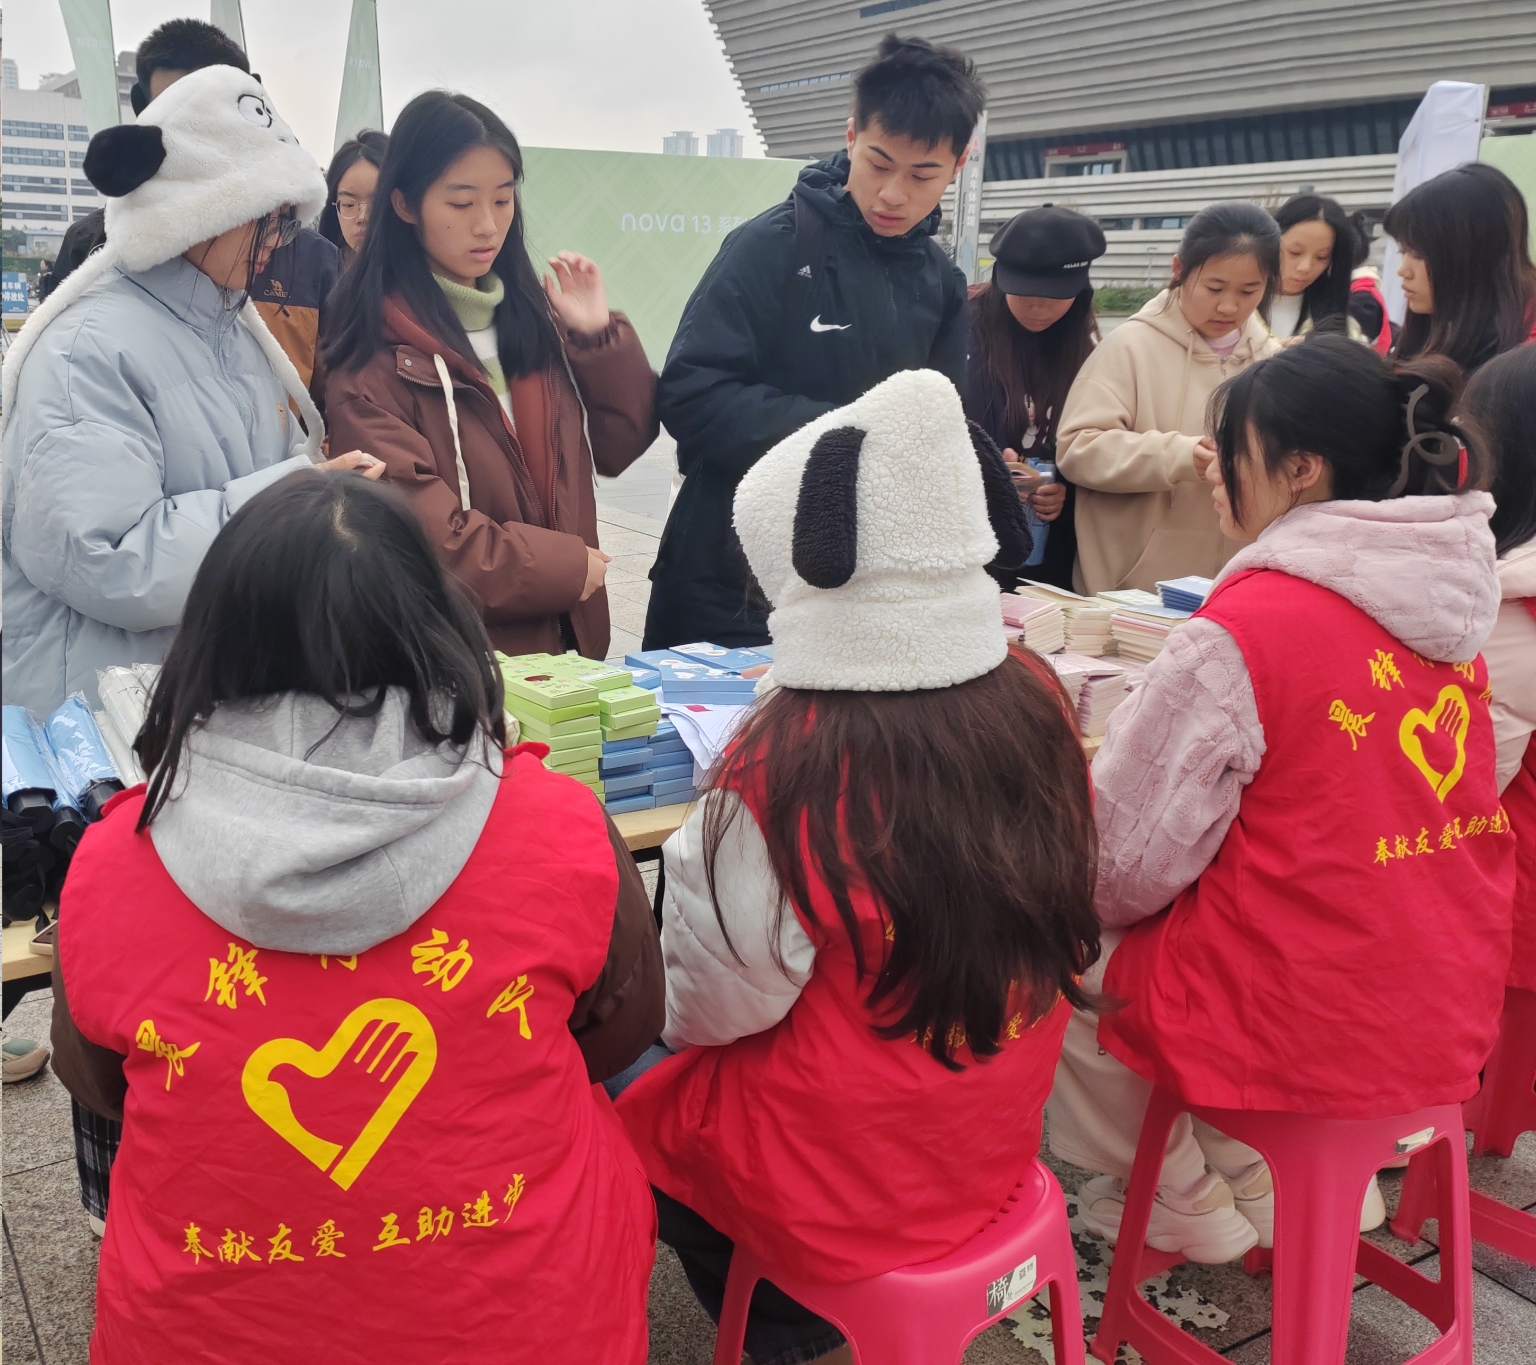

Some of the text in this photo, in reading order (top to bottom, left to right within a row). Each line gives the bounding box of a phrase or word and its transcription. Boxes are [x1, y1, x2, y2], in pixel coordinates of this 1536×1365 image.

[621, 212, 686, 233] nova
[691, 214, 712, 234] 13
[1373, 822, 1458, 868] 奉献友爱
[182, 1172, 526, 1266] 奉献友爱 互助进步
